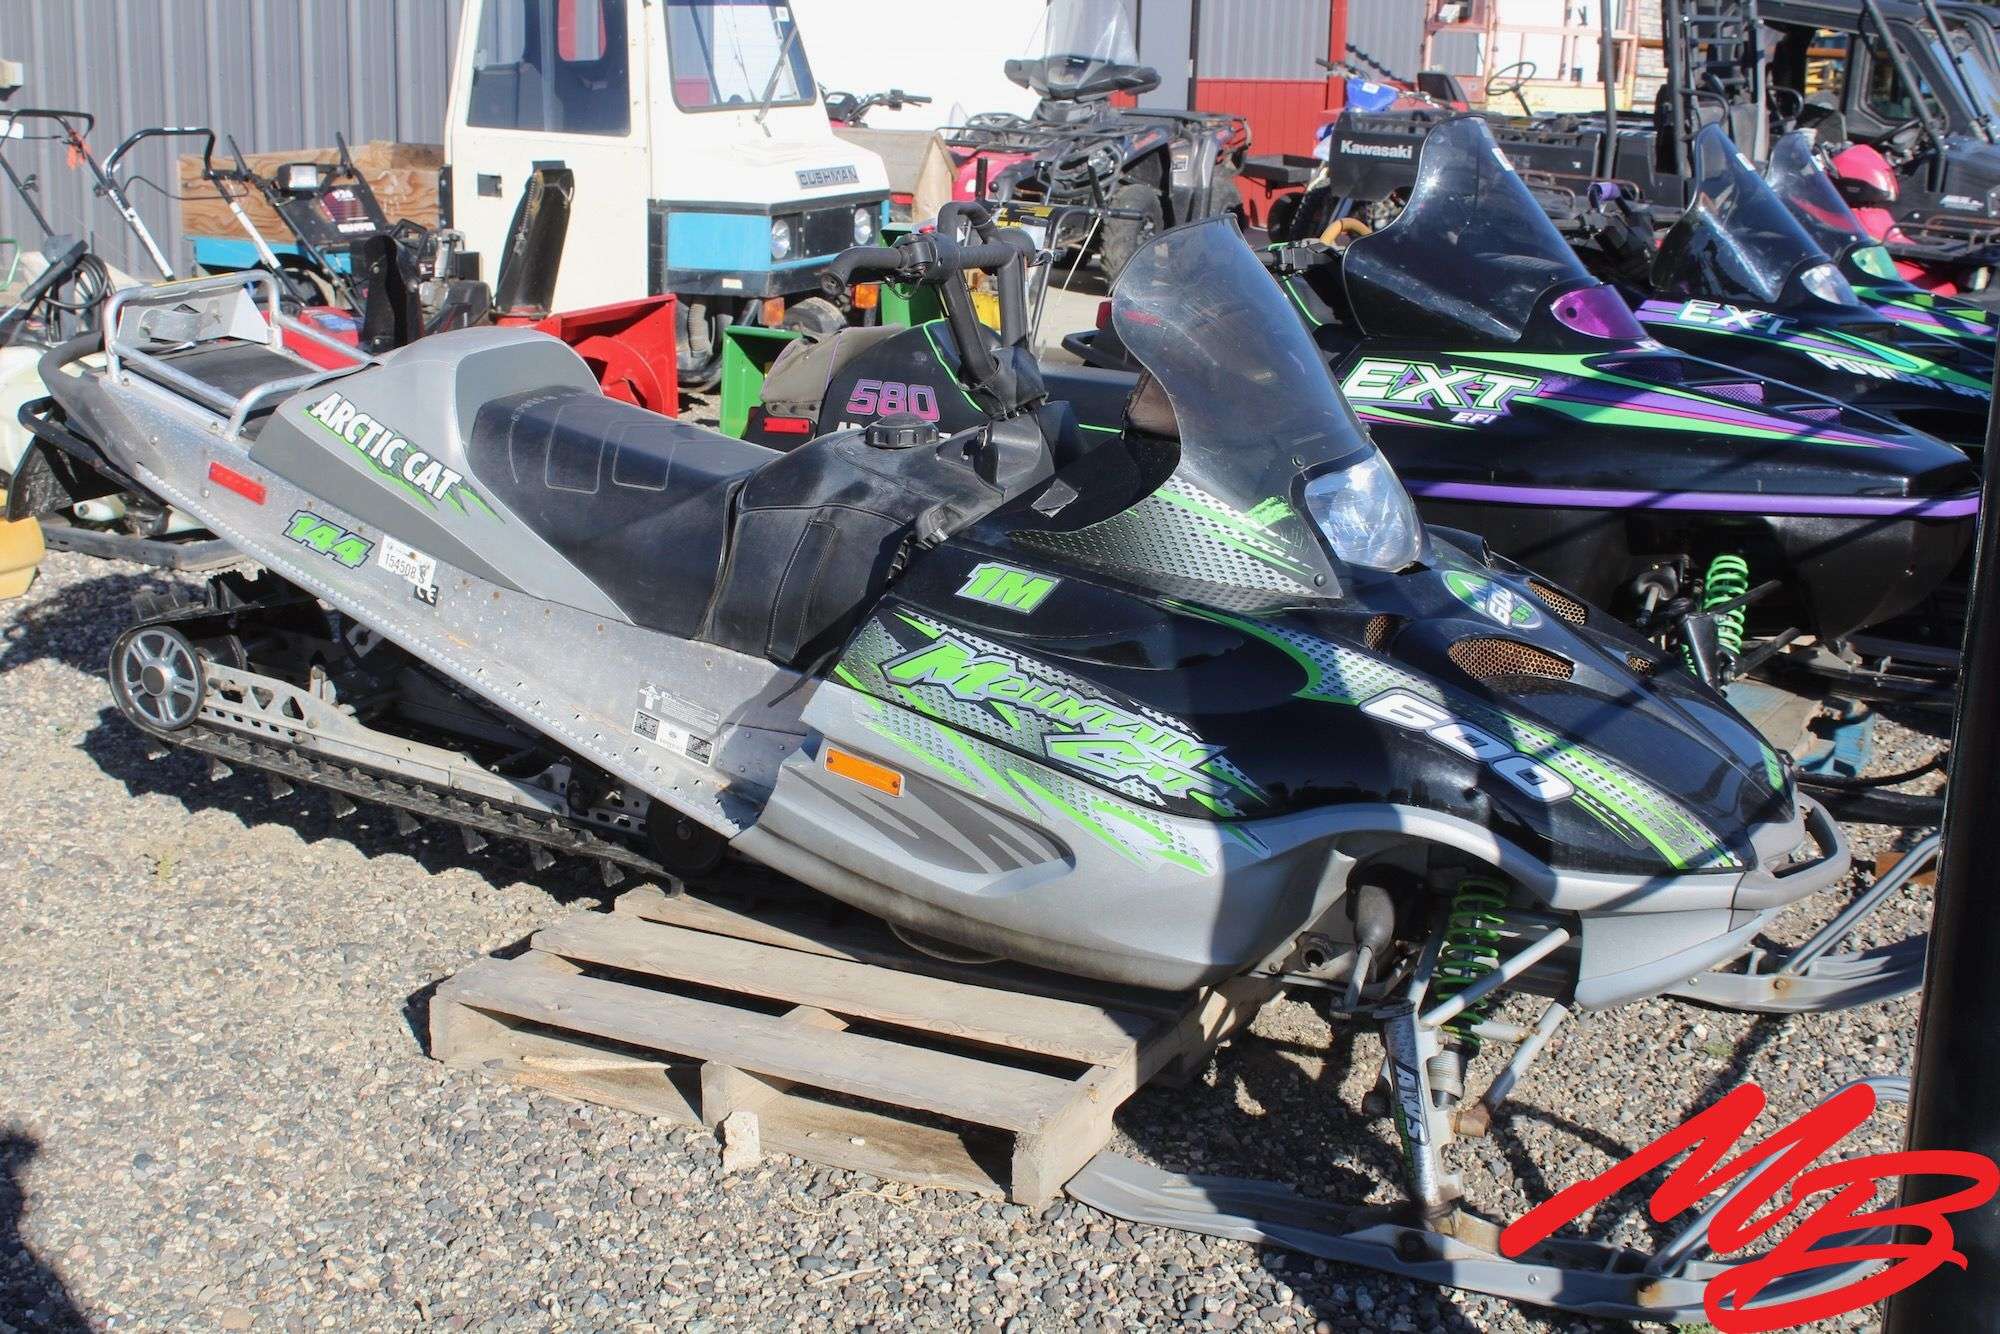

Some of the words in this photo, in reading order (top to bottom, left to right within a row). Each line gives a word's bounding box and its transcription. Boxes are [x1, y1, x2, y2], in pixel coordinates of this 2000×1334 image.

[1341, 140, 1412, 159] Kawasaki
[799, 167, 858, 186] CUSHMAN
[1679, 299, 1798, 335] EXT
[846, 379, 940, 422] 580
[1342, 358, 1541, 411] EXT
[1451, 412, 1498, 424] EFI
[309, 391, 408, 470] ARCTIC
[402, 451, 463, 501] CAT
[283, 511, 373, 568] 144
[956, 562, 1061, 615] 1M
[1363, 691, 1574, 802] 600
